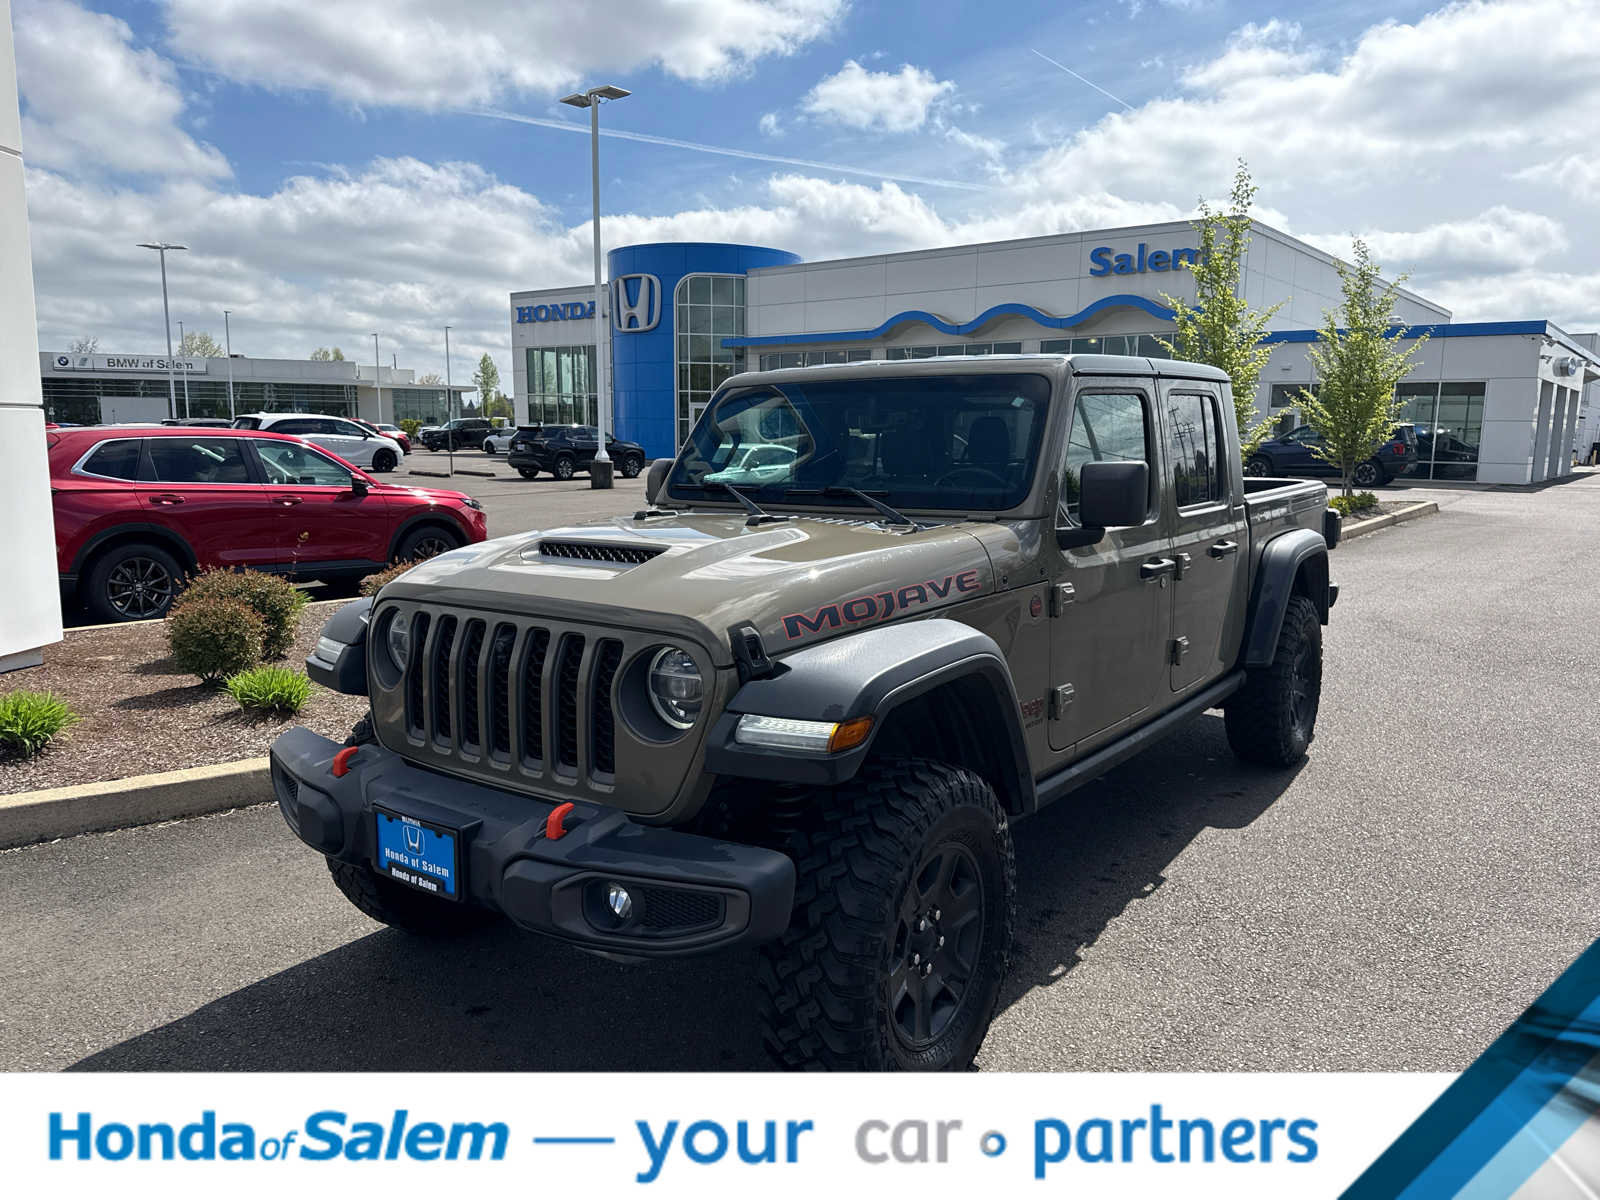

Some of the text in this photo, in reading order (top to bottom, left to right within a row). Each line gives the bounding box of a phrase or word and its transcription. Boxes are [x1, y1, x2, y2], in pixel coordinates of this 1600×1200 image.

[107, 358, 139, 368] BMW
[142, 359, 155, 368] of
[782, 568, 982, 640] MOJAVE
[385, 848, 448, 877] Honda of Salem
[392, 867, 410, 881] Honda
